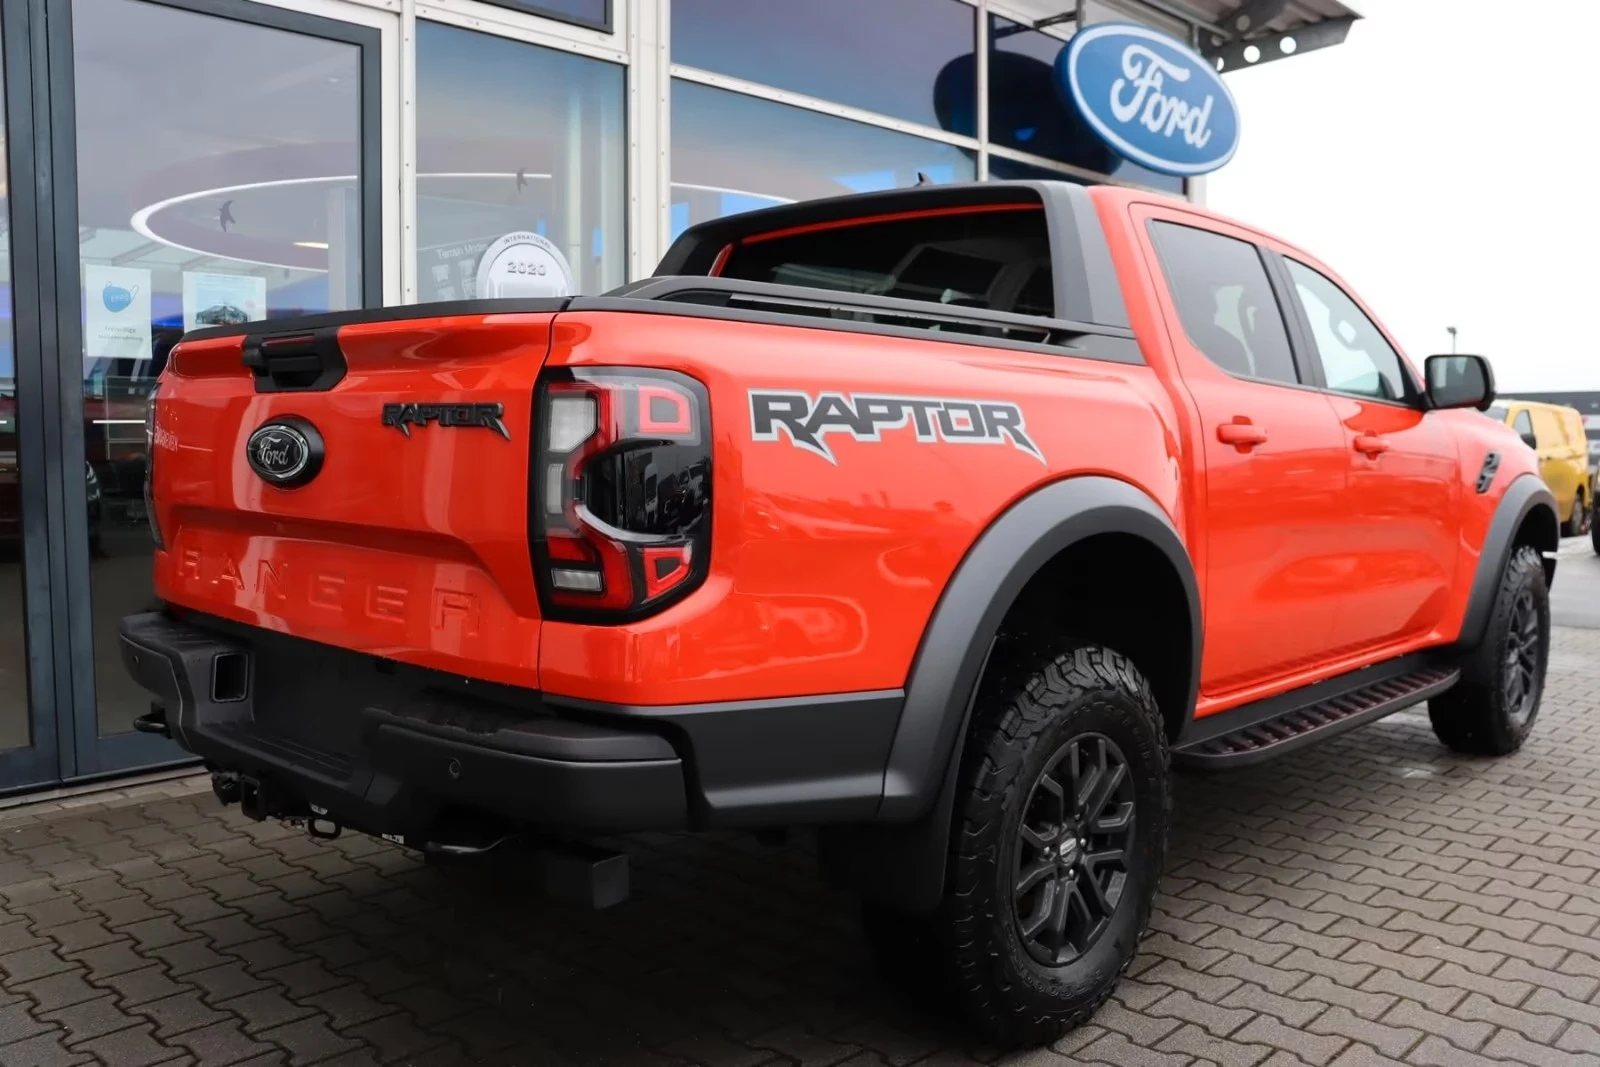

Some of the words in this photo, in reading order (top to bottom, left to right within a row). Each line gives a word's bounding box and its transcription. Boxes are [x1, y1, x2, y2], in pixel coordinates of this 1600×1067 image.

[1109, 44, 1214, 149] Ford
[503, 234, 551, 249] INTERNATIONAL
[507, 261, 546, 276] 2020
[382, 402, 511, 440] RAPTOR
[747, 388, 1048, 466] RAPTOR
[257, 436, 289, 468] Ford
[178, 550, 481, 637] RANGER
